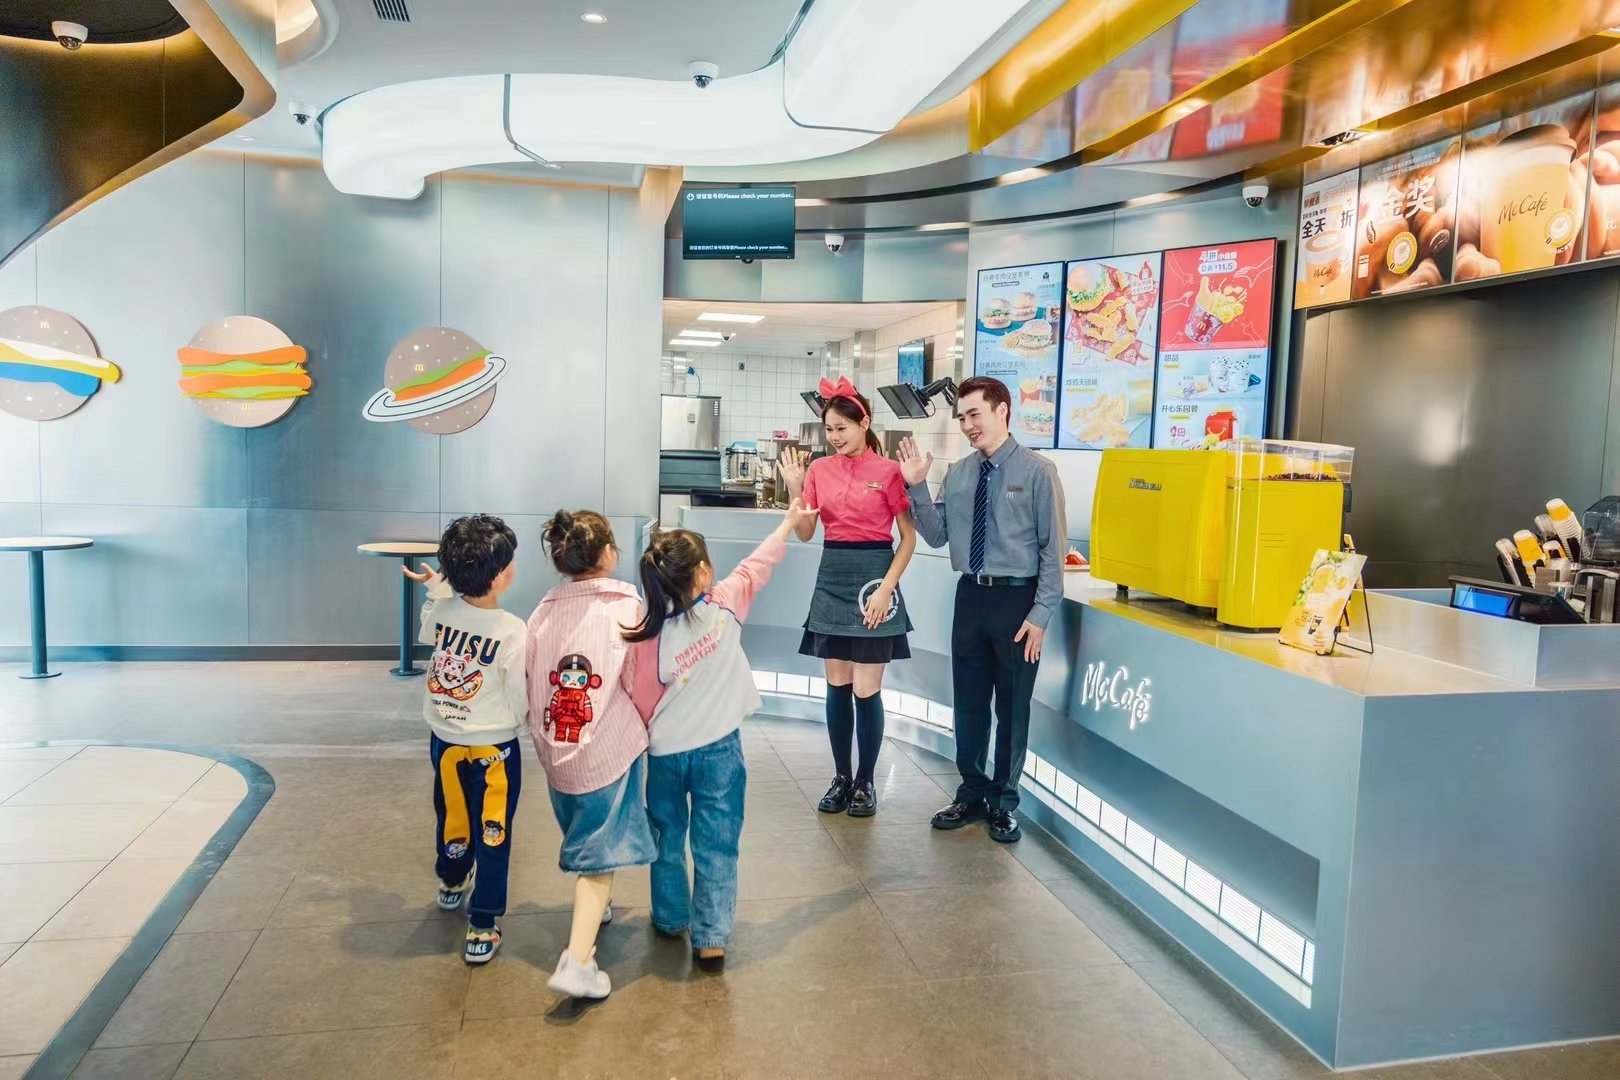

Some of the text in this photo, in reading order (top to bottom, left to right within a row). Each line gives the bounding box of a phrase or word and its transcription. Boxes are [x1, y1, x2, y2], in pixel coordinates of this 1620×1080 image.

[1498, 192, 1549, 225] McCafé
[1301, 217, 1327, 239] 全天
[1341, 209, 1354, 229] 折
[1160, 404, 1199, 413] 开心乐园餐
[1081, 661, 1152, 730] McCafé
[467, 943, 488, 954] NIKE
